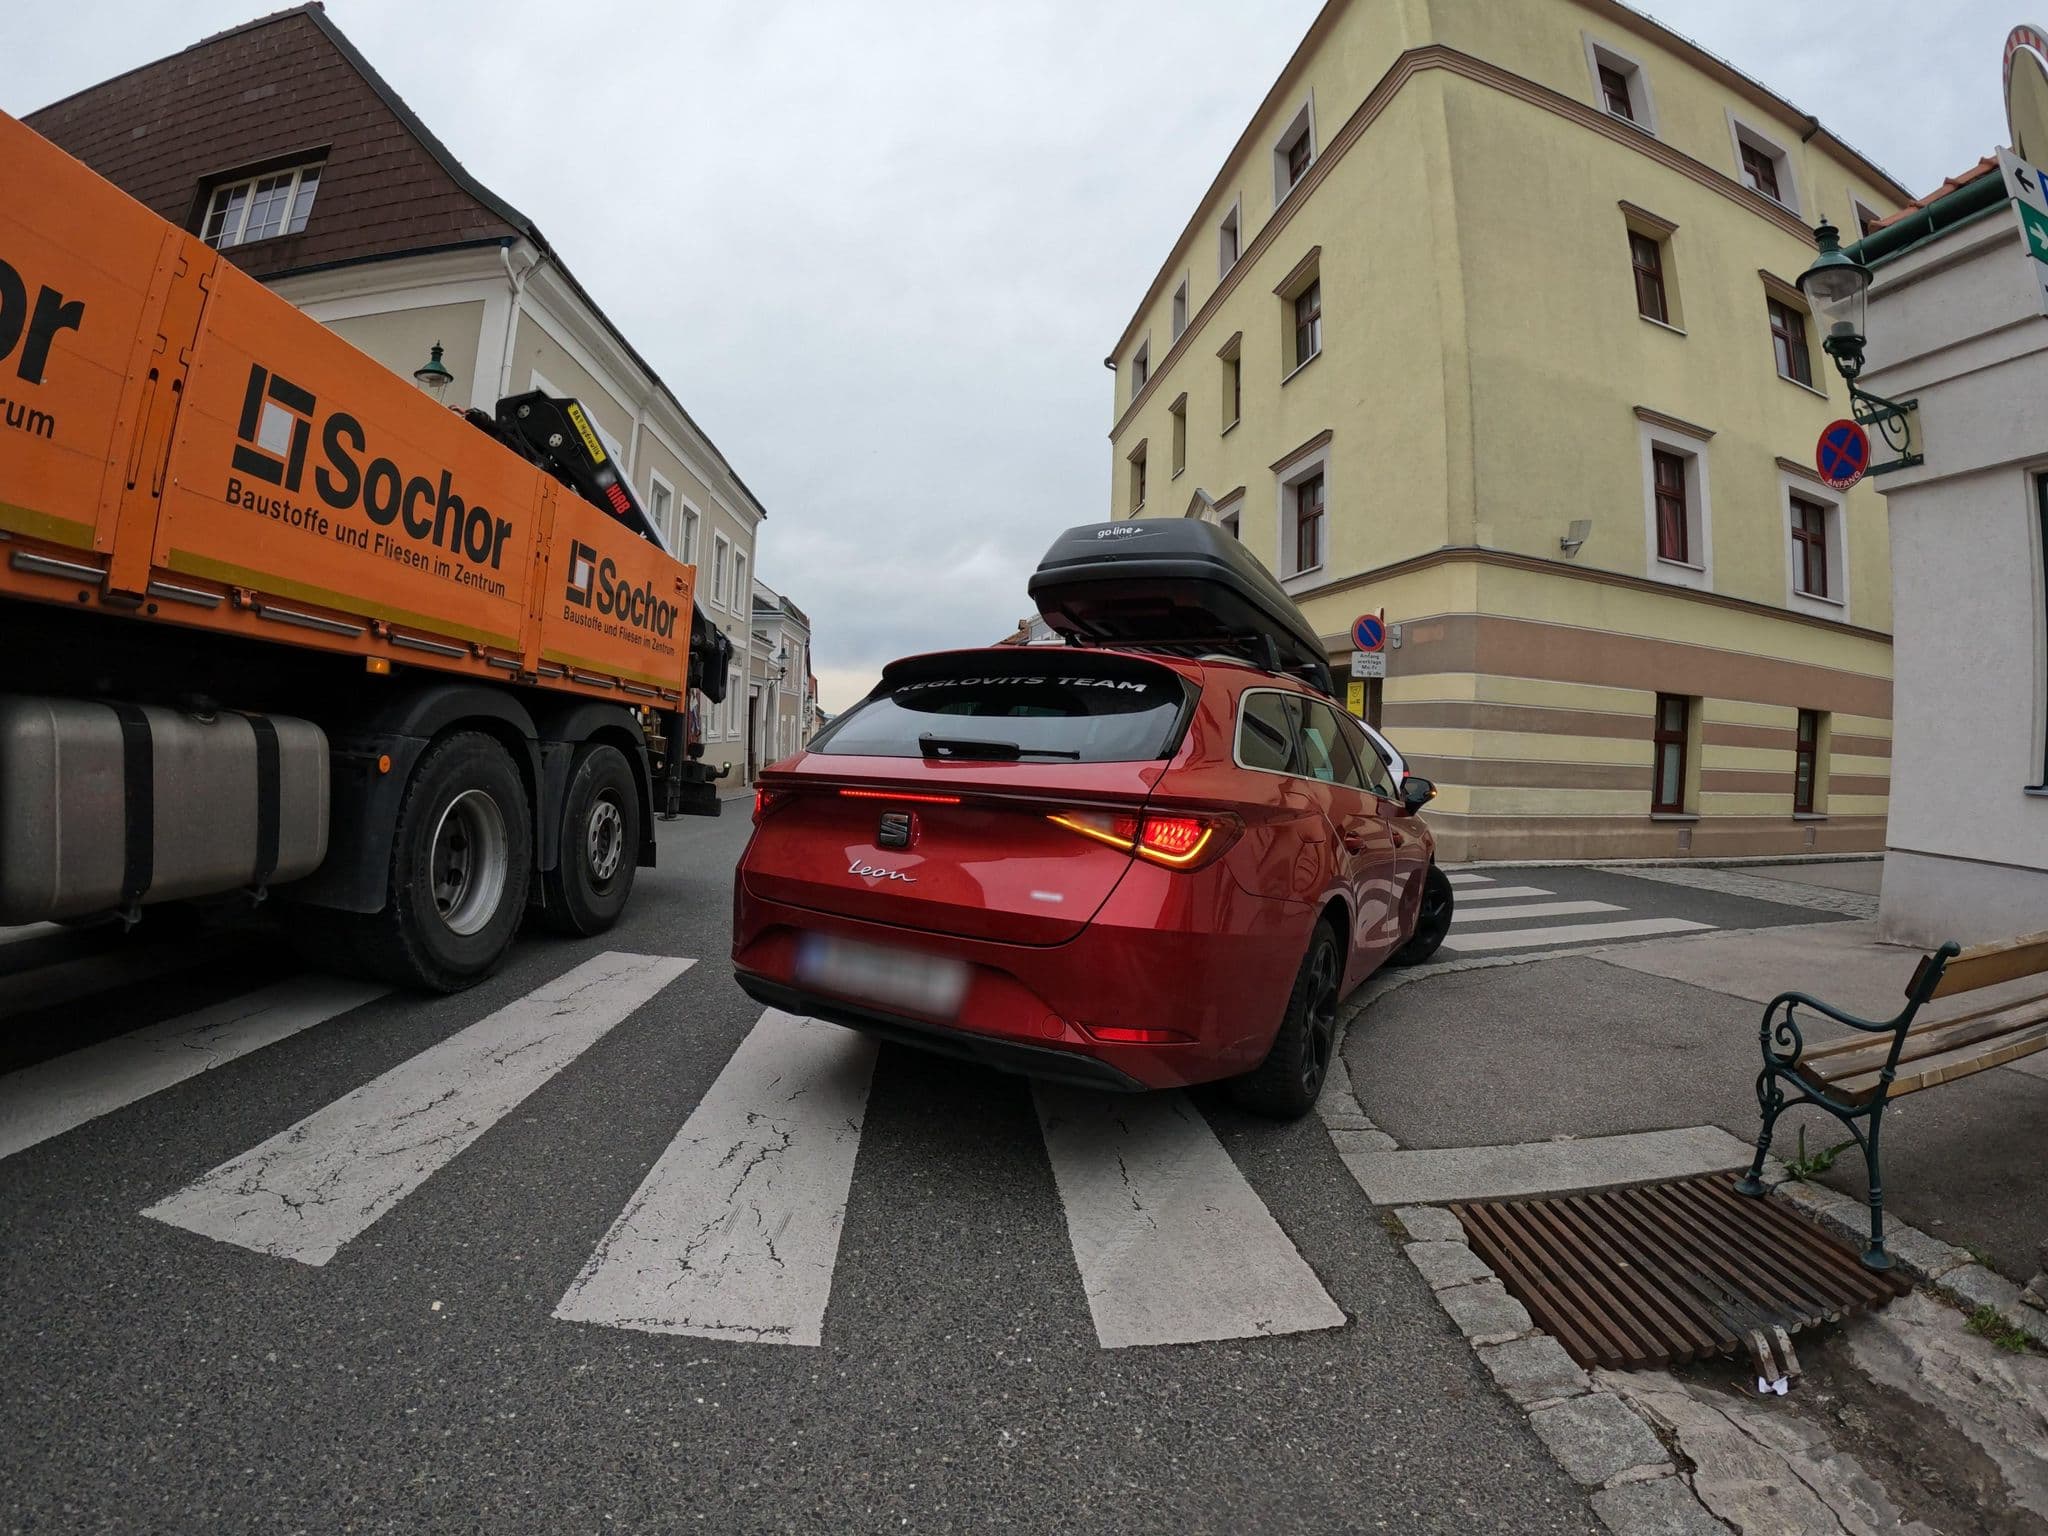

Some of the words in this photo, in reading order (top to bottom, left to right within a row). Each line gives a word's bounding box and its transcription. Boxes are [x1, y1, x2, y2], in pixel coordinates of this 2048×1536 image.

[315, 412, 512, 569] Sochor
[1827, 470, 1861, 488] ANFANG
[606, 484, 630, 514] HIAB
[226, 477, 329, 535] Baustoffe
[335, 523, 369, 550] und
[374, 532, 429, 571] Fliesen
[434, 555, 450, 578] im
[455, 563, 506, 598] Zentrum
[1097, 529, 1112, 539] go
[1113, 525, 1134, 535] line
[597, 558, 678, 639] Sochor
[564, 606, 602, 631] Baustoffe
[604, 622, 618, 637] und
[619, 626, 642, 646] Fliesen
[643, 634, 651, 648] im
[652, 638, 675, 656] Zentrum
[896, 677, 1046, 692] KEGLOVITS
[1058, 677, 1147, 692] TEAM
[847, 859, 918, 882] Leon
